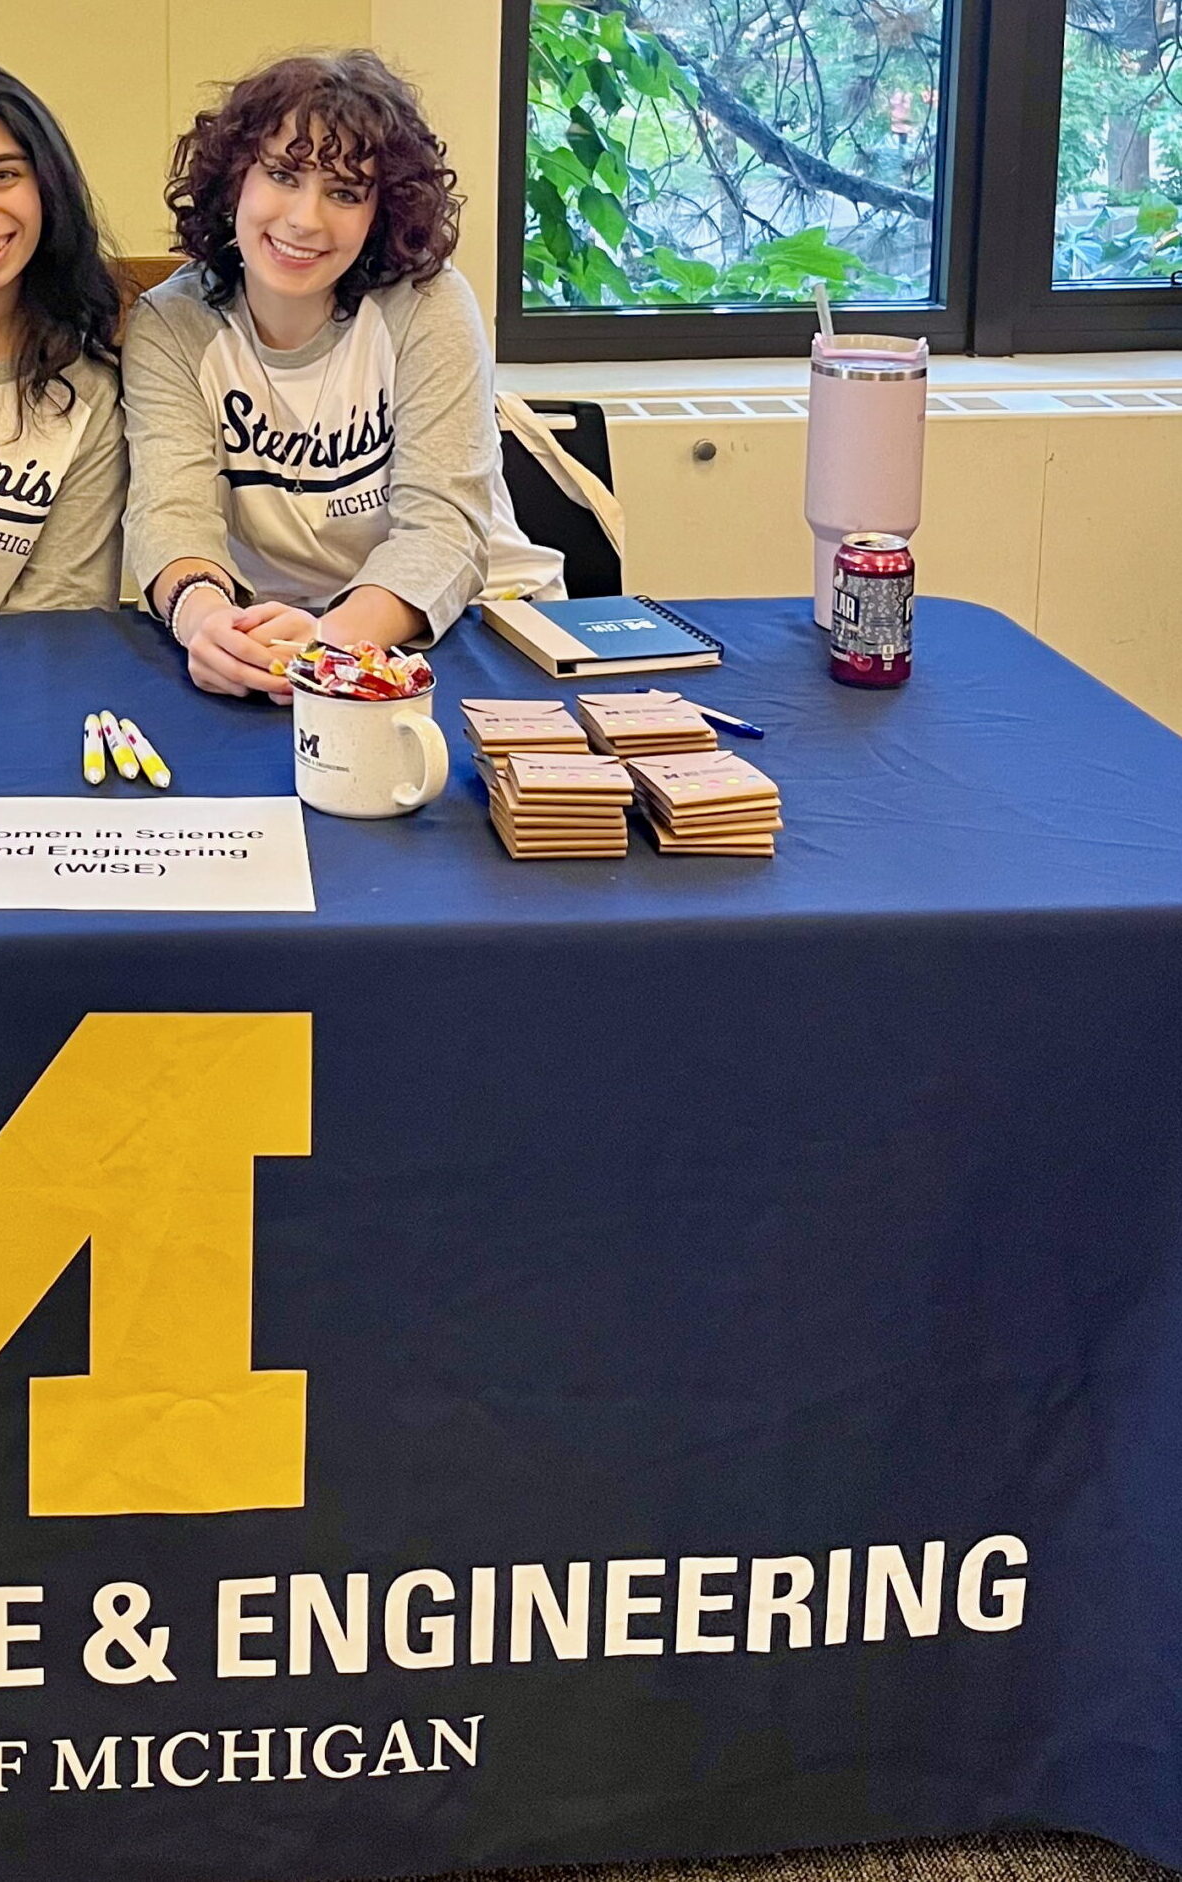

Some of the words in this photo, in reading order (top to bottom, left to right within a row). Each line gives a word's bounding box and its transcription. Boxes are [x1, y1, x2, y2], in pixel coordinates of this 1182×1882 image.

[221, 388, 395, 468] Steminist
[299, 728, 319, 758] M
[95, 828, 123, 839] in
[135, 828, 265, 840] Science
[47, 845, 248, 859] Engineering
[53, 862, 167, 877] (WISE)
[82, 1581, 176, 1684] &
[217, 1534, 1029, 1678] ENGINEERING
[50, 1715, 485, 1793] MICHIGAN
